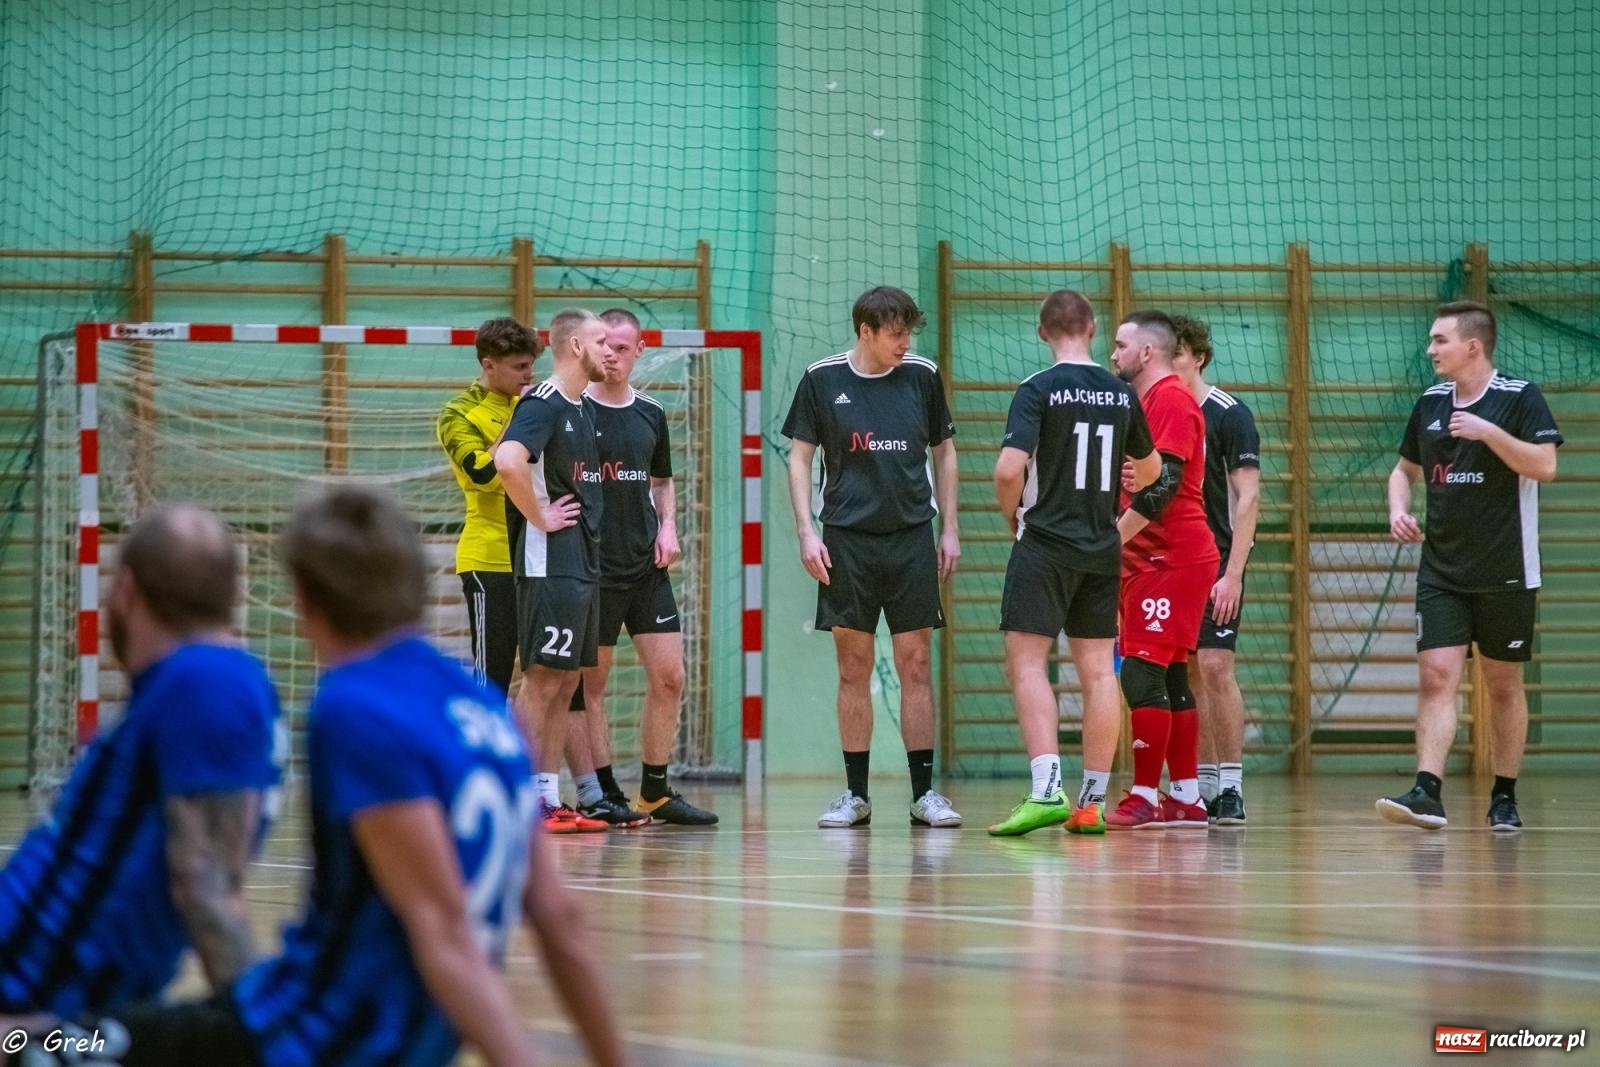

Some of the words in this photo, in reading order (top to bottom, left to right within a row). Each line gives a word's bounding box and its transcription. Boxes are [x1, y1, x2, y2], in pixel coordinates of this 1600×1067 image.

[1049, 388, 1115, 406] MAJCHER
[849, 431, 908, 453] Nexans
[1073, 421, 1114, 492] 11
[601, 461, 647, 481] Nexans
[1430, 463, 1484, 484] Nexans
[1141, 597, 1171, 620] 98
[541, 625, 574, 658] 22
